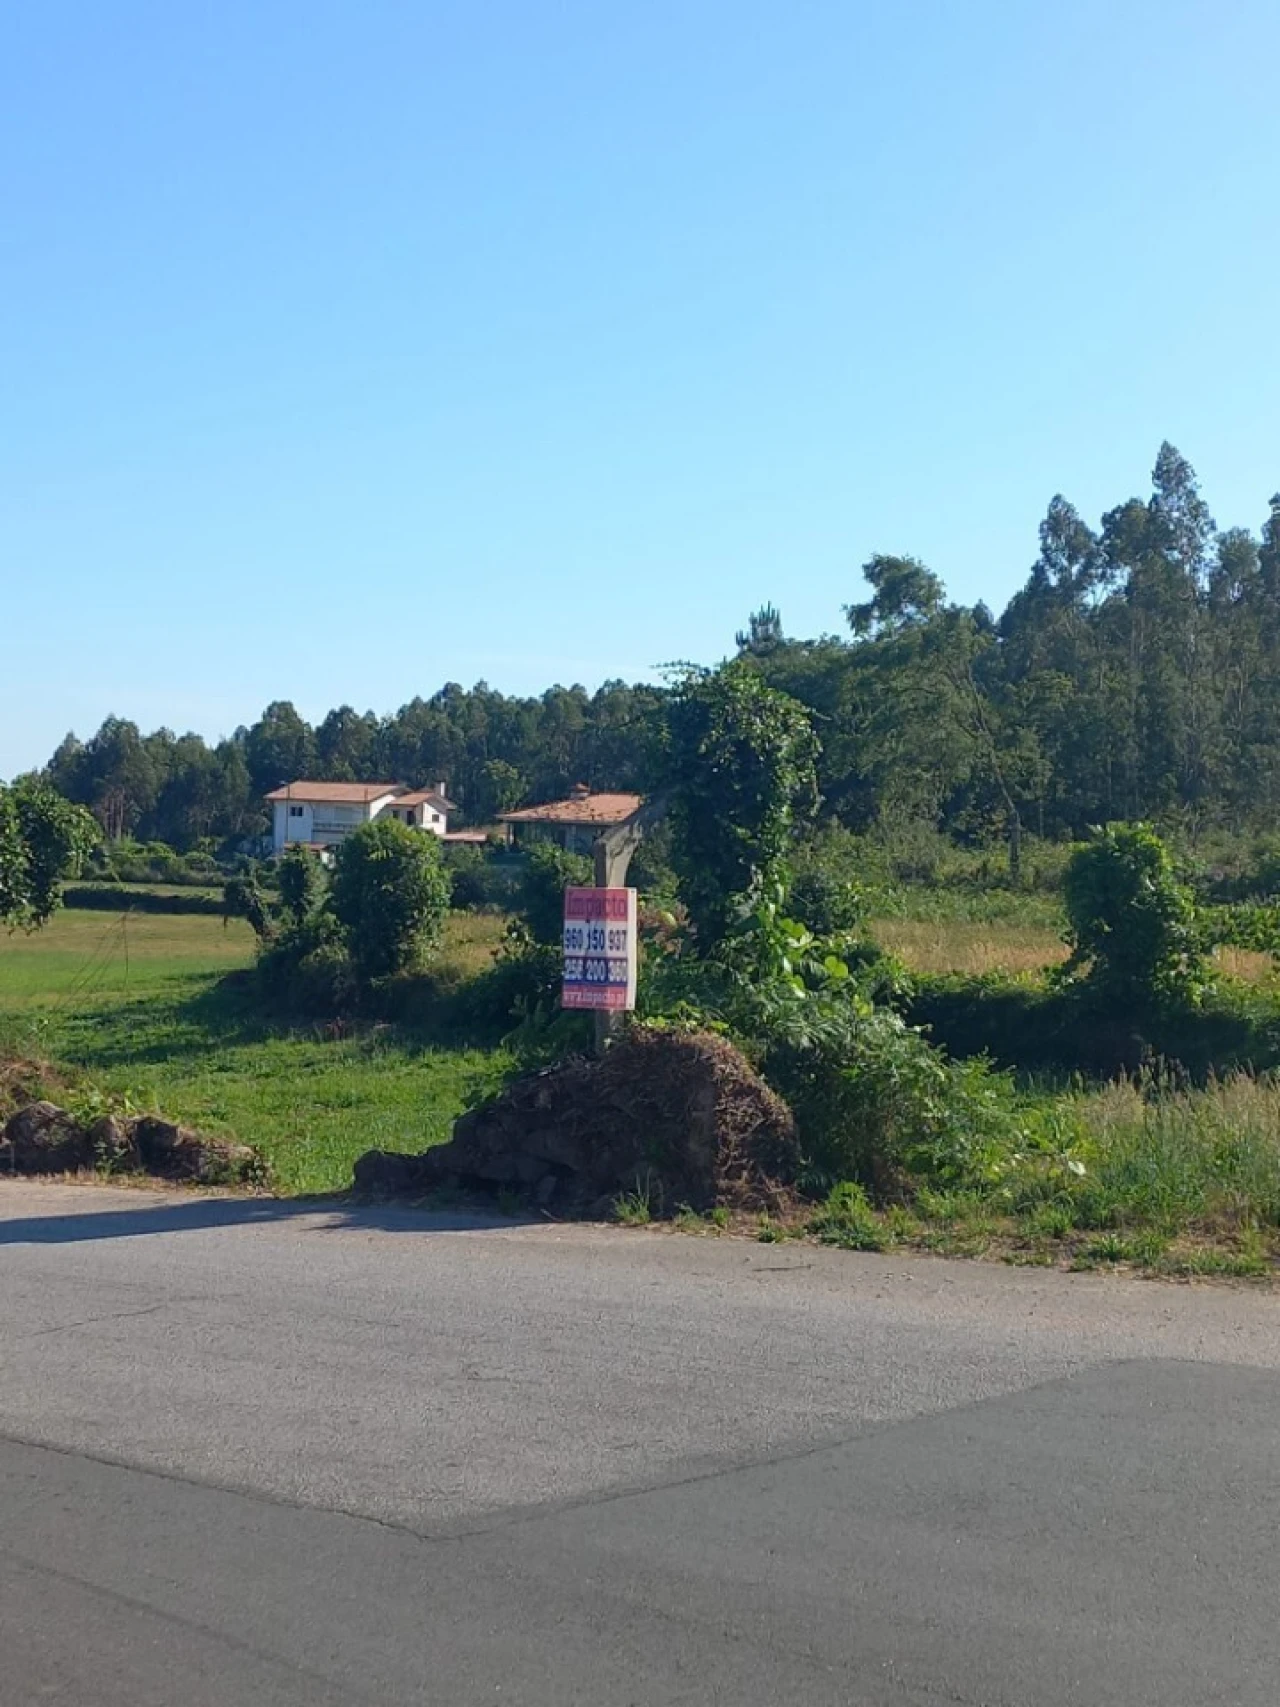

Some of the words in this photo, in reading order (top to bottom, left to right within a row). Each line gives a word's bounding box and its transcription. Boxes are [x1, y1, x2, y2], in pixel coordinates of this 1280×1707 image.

[566, 891, 627, 921] Impacto
[587, 929, 605, 951] 150
[608, 930, 627, 951] 937
[586, 959, 605, 981] 200
